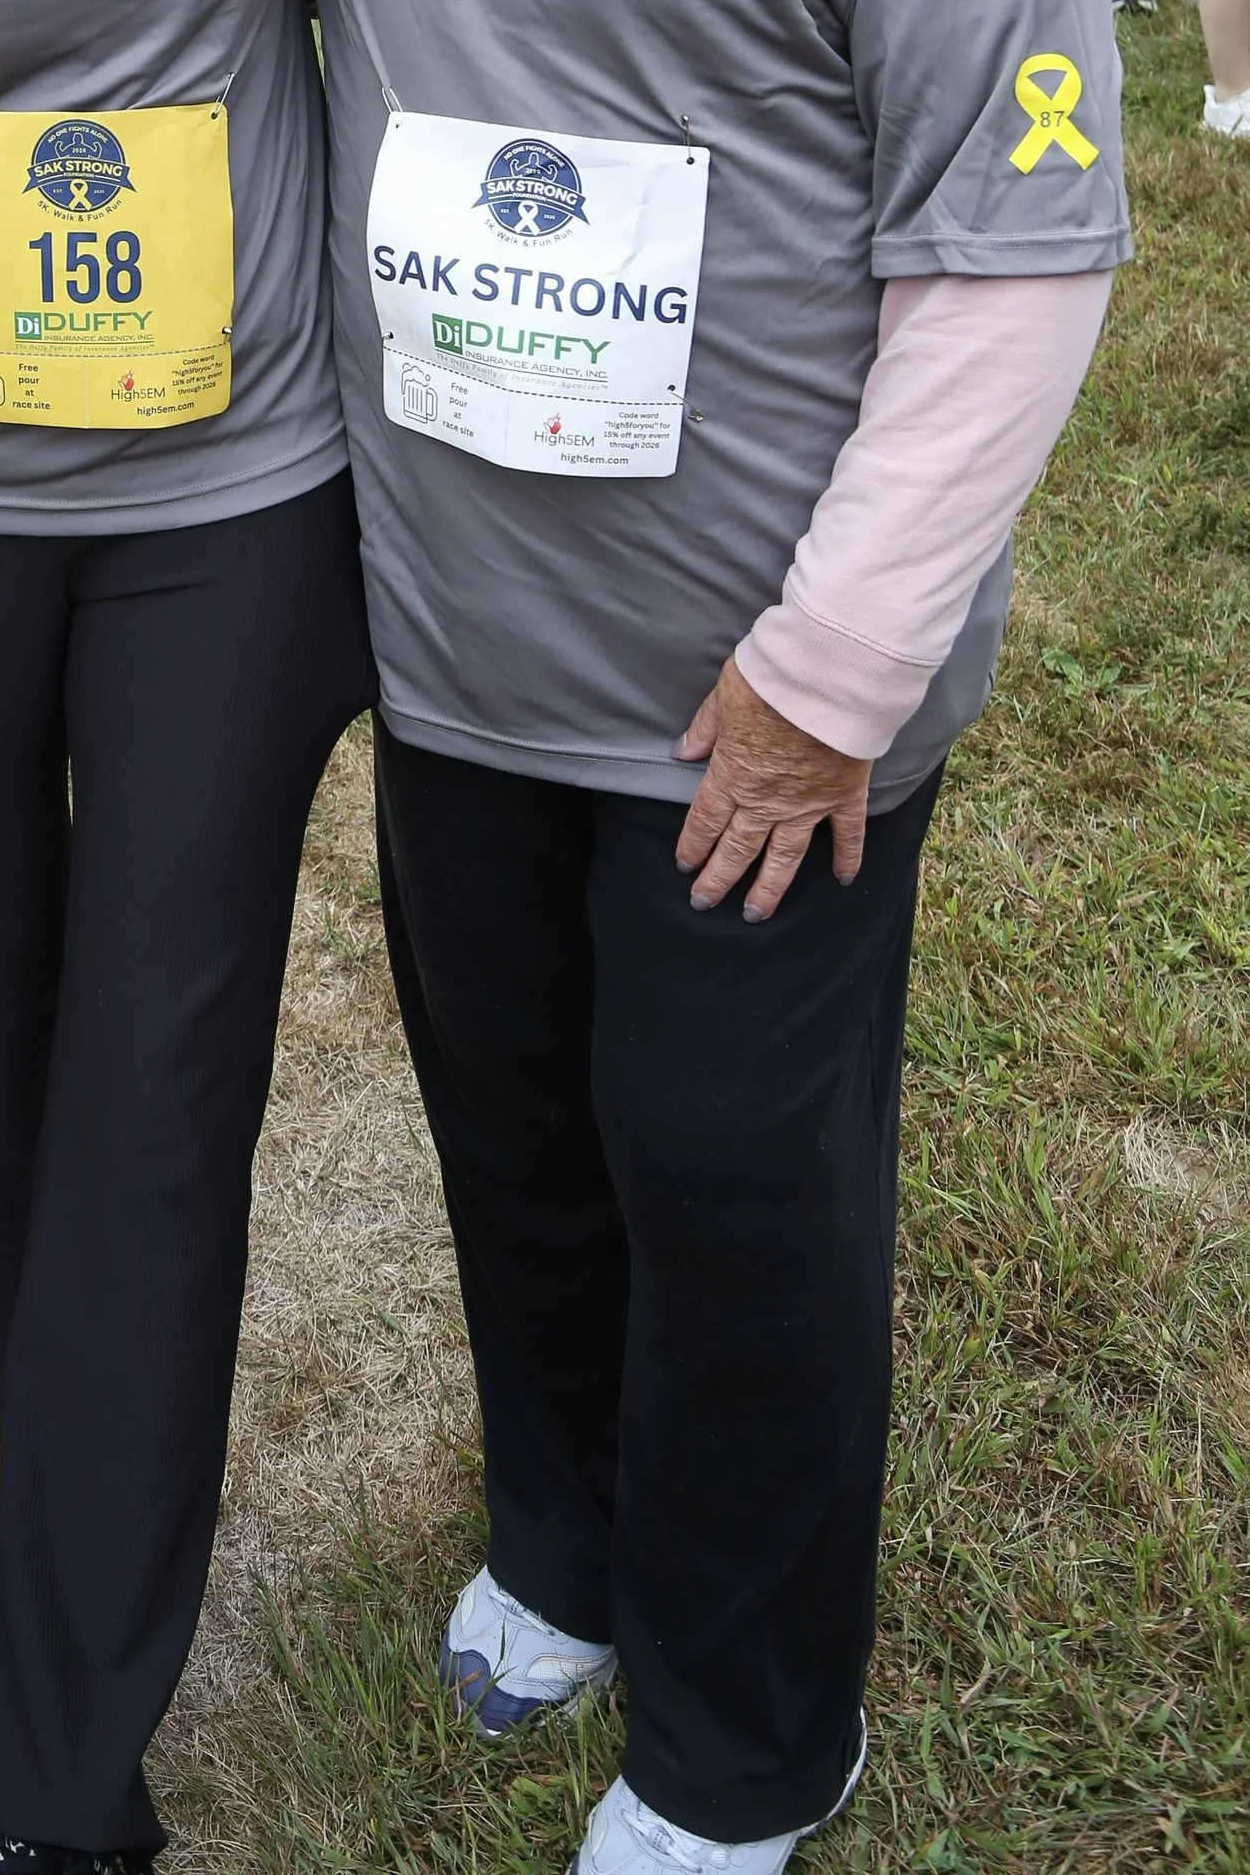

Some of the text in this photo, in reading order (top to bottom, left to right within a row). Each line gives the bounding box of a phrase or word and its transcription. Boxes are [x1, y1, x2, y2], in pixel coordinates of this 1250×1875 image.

[1040, 111, 1065, 128] 87
[47, 135, 56, 143] NO
[56, 128, 68, 136] ONE
[90, 129, 108, 143] ALONE
[503, 146, 565, 168] NO ONE FIGHTS ALONE
[34, 161, 123, 177] SAK STRONG
[486, 180, 578, 205] SAK STRONG
[37, 200, 50, 214] 5K,
[53, 209, 75, 221] Walk
[87, 211, 105, 221] Fun
[106, 199, 123, 213] Run
[497, 230, 518, 244] Walk
[554, 229, 573, 242] Run
[29, 230, 142, 304] 158
[373, 244, 688, 325] SAK STRONG
[44, 311, 153, 331] DUFFY
[466, 320, 611, 364] DUFFY
[200, 355, 215, 363] word
[465, 350, 609, 379] INSURANCE AGENCY, INC.
[19, 363, 38, 371] Free
[436, 353, 449, 362] The
[450, 357, 470, 370] Duffy
[472, 363, 498, 378] Family
[499, 371, 508, 381] of
[511, 374, 557, 387] Insurance
[19, 377, 40, 385] pour
[196, 375, 207, 383] any
[207, 371, 222, 379] event
[111, 387, 166, 402] High5EM
[178, 385, 202, 395] through
[451, 382, 468, 395] Free
[34, 401, 50, 409] site
[137, 402, 194, 416] high5em.com
[449, 397, 468, 408] pour
[454, 411, 461, 420] at
[618, 411, 638, 419] Code
[443, 421, 474, 437] race site
[534, 430, 595, 447] High5EM
[632, 433, 646, 441] any
[560, 453, 629, 465] high5em.com
